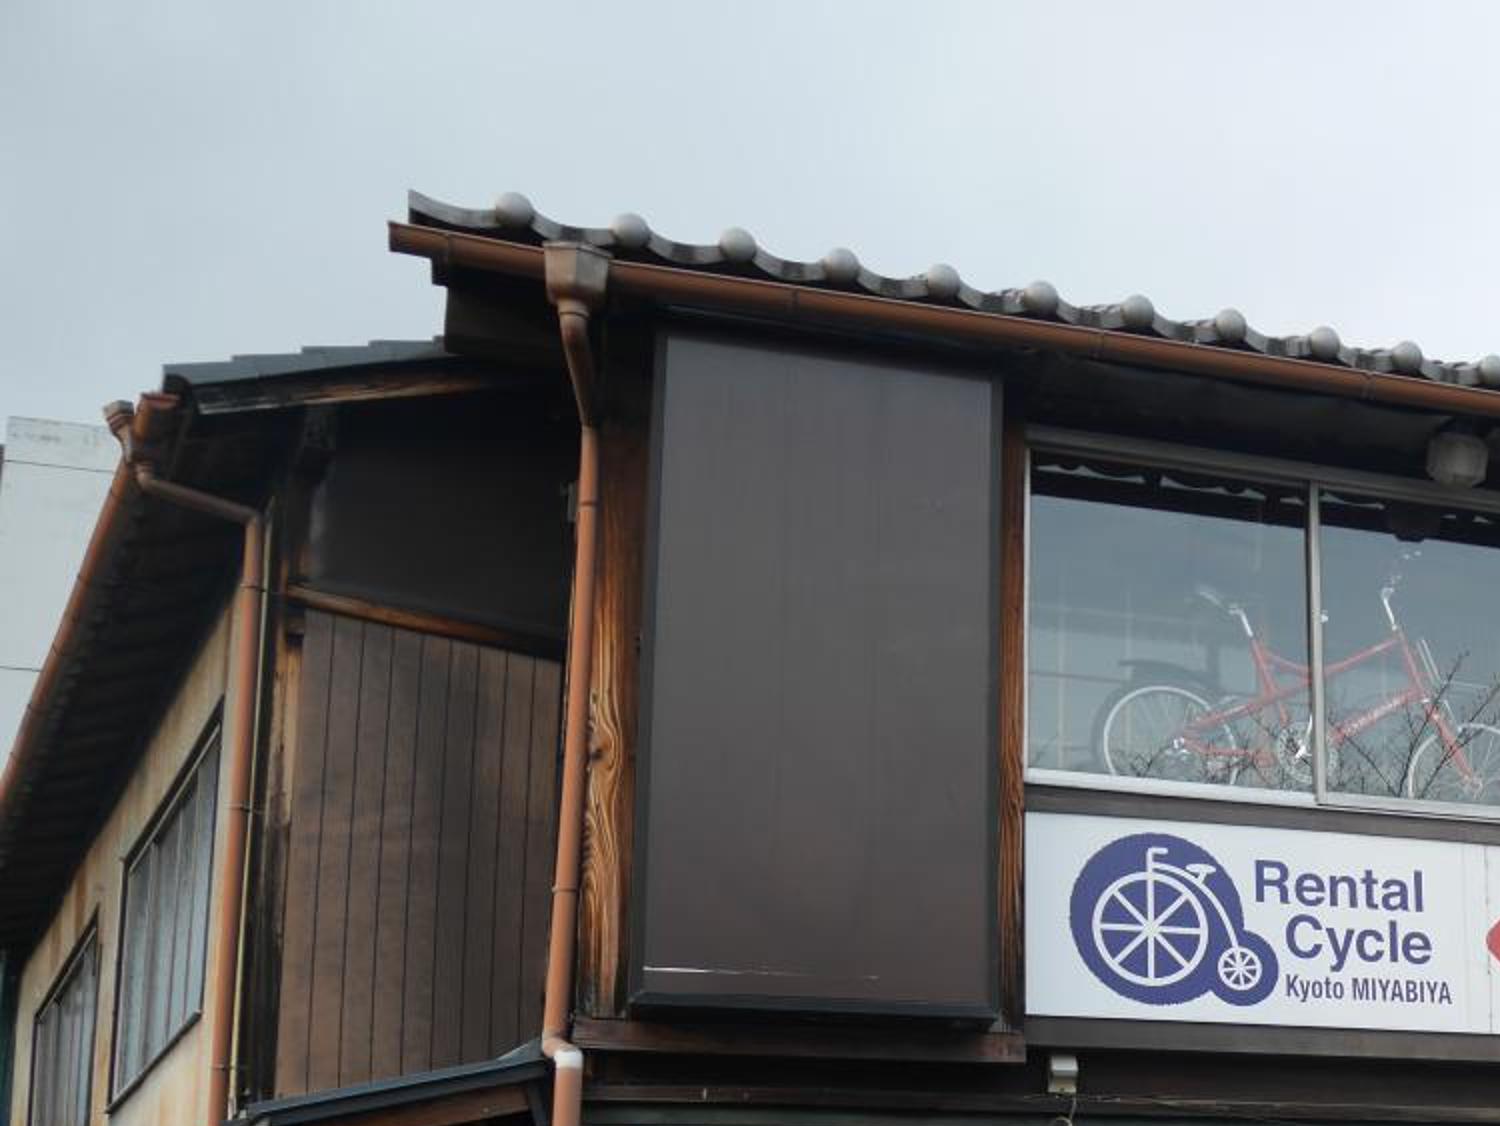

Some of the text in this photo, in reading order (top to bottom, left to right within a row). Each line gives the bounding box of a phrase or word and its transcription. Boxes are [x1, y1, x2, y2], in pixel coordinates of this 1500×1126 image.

[1254, 858, 1425, 914] Rental
[1285, 913, 1433, 972] Cycle
[1284, 974, 1453, 1006] Kyoto MIYABIYA
